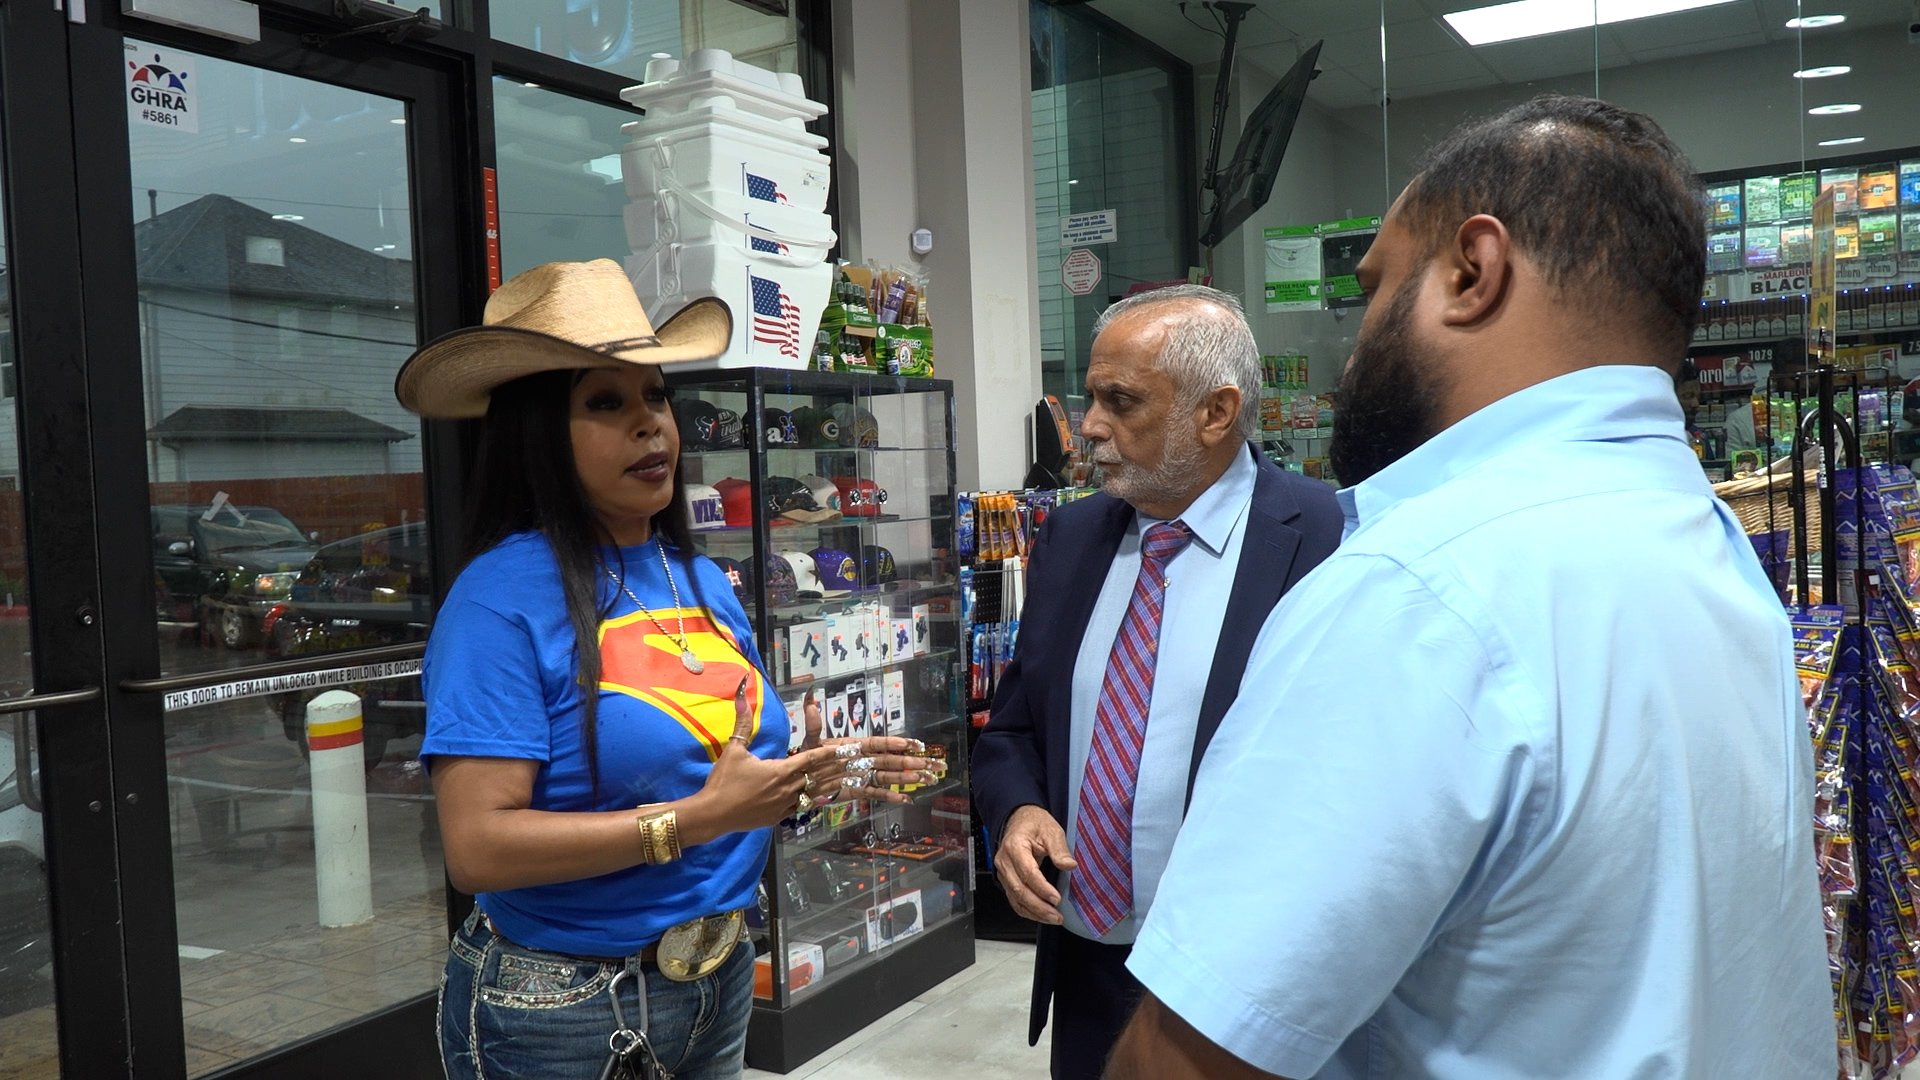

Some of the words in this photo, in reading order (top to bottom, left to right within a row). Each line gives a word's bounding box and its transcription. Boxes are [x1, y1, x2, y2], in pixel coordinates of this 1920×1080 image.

[131, 86, 187, 113] GHRA
[142, 109, 178, 126] #5861
[1750, 349, 1773, 362] 1079
[1700, 368, 1722, 384] oro
[692, 498, 722, 523] VIK
[166, 691, 189, 709] THIS
[191, 688, 218, 705] DOOR
[220, 685, 233, 699] TO
[235, 679, 271, 697] REMAIN
[273, 672, 317, 691] UNLOCKED
[320, 669, 345, 685] WHILE
[346, 665, 383, 681] BUILDING
[384, 663, 393, 676] IS
